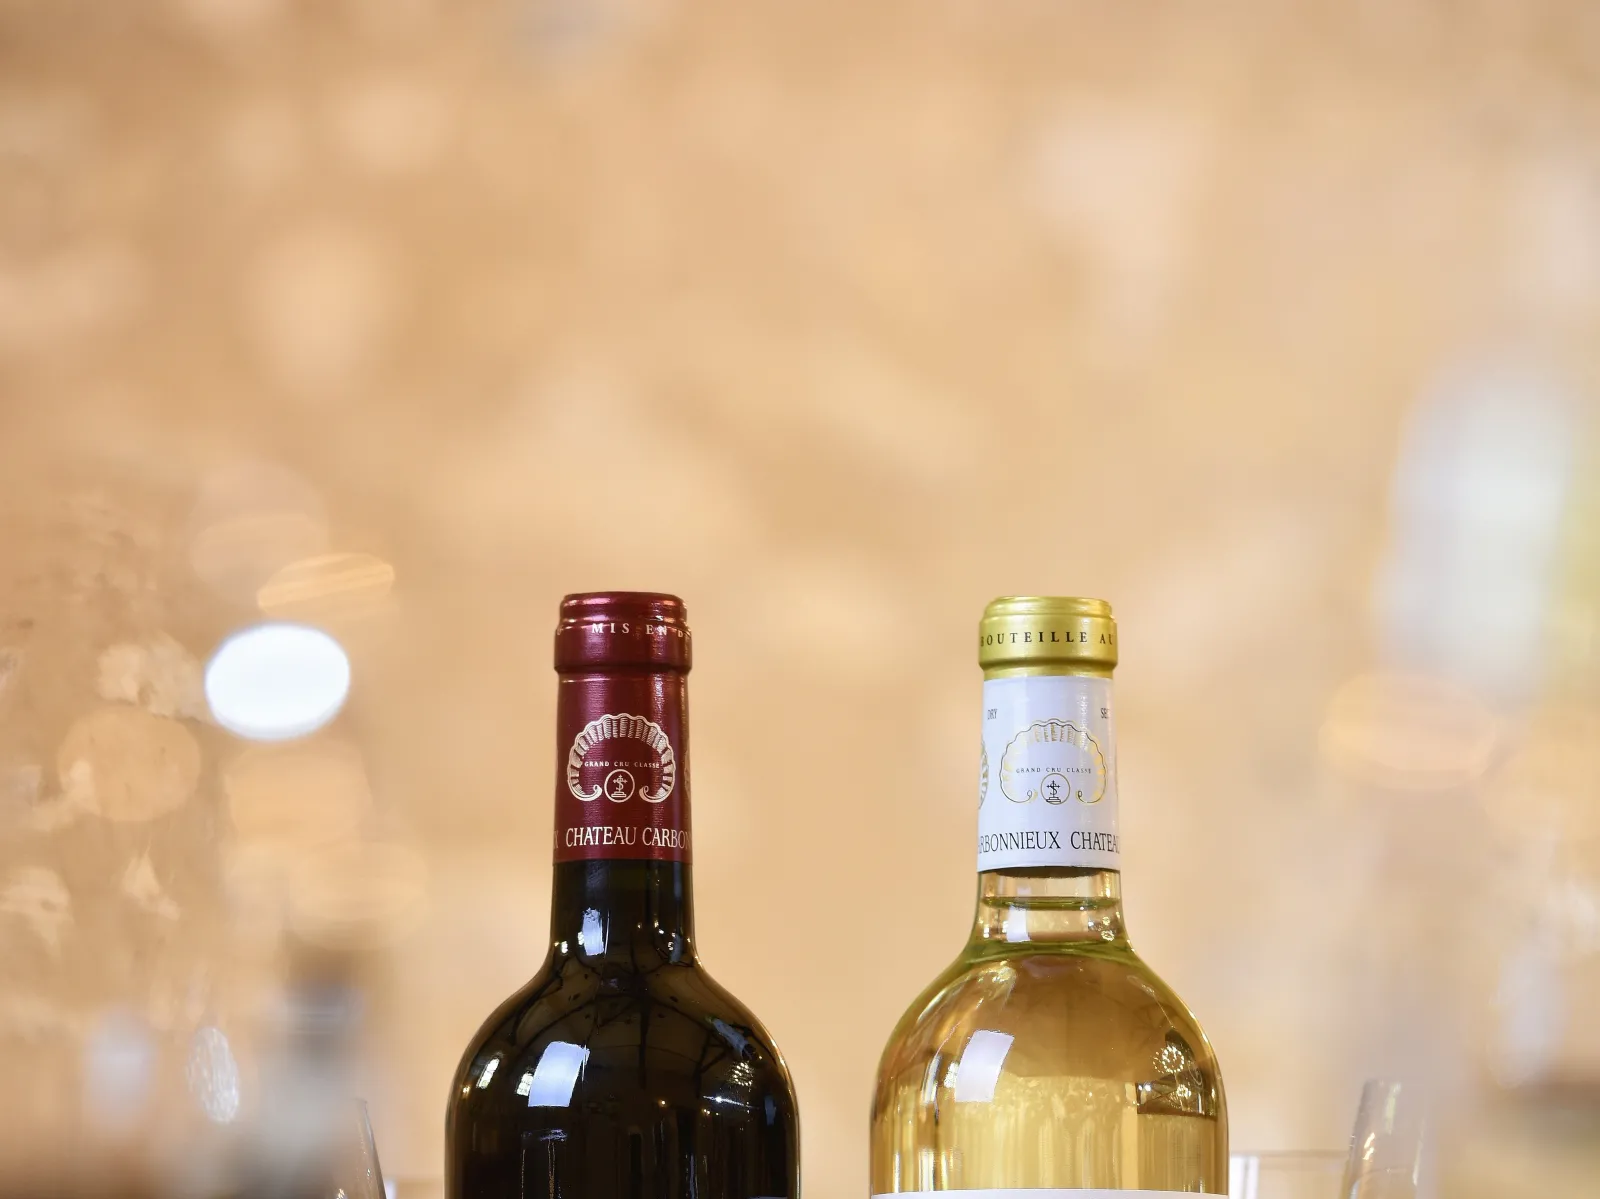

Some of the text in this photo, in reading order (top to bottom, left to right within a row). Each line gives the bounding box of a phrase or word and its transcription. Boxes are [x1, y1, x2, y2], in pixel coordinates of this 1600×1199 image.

[591, 622, 631, 635] MIS
[584, 760, 610, 768] GRAND
[566, 826, 637, 847] CHATEAU
[978, 831, 1119, 854] RBONNIEUX CHATEA
